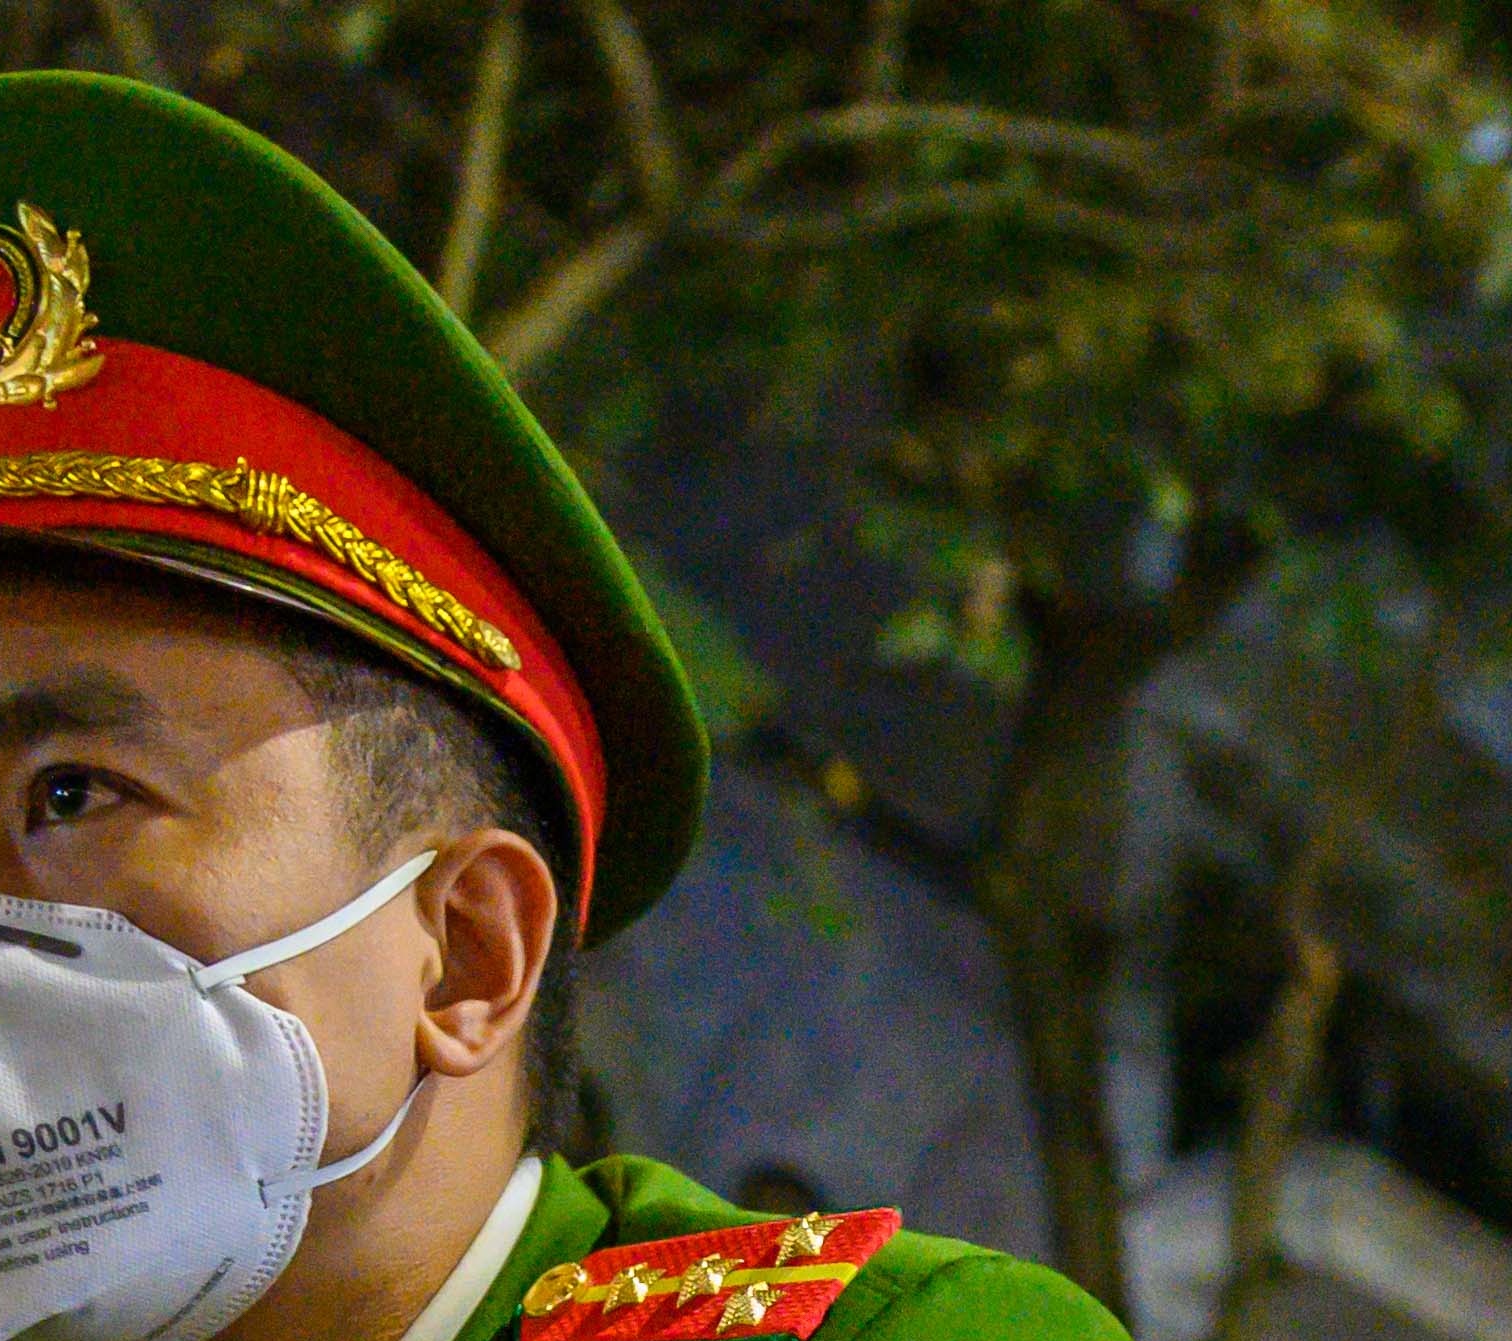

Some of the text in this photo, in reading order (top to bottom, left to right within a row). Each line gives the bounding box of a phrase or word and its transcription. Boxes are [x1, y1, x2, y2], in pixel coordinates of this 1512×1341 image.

[11, 1102, 126, 1158] 9001V
[80, 1170, 105, 1188] P1
[17, 1226, 53, 1245] user
[57, 1201, 150, 1235] instructions
[43, 1239, 91, 1262] using
